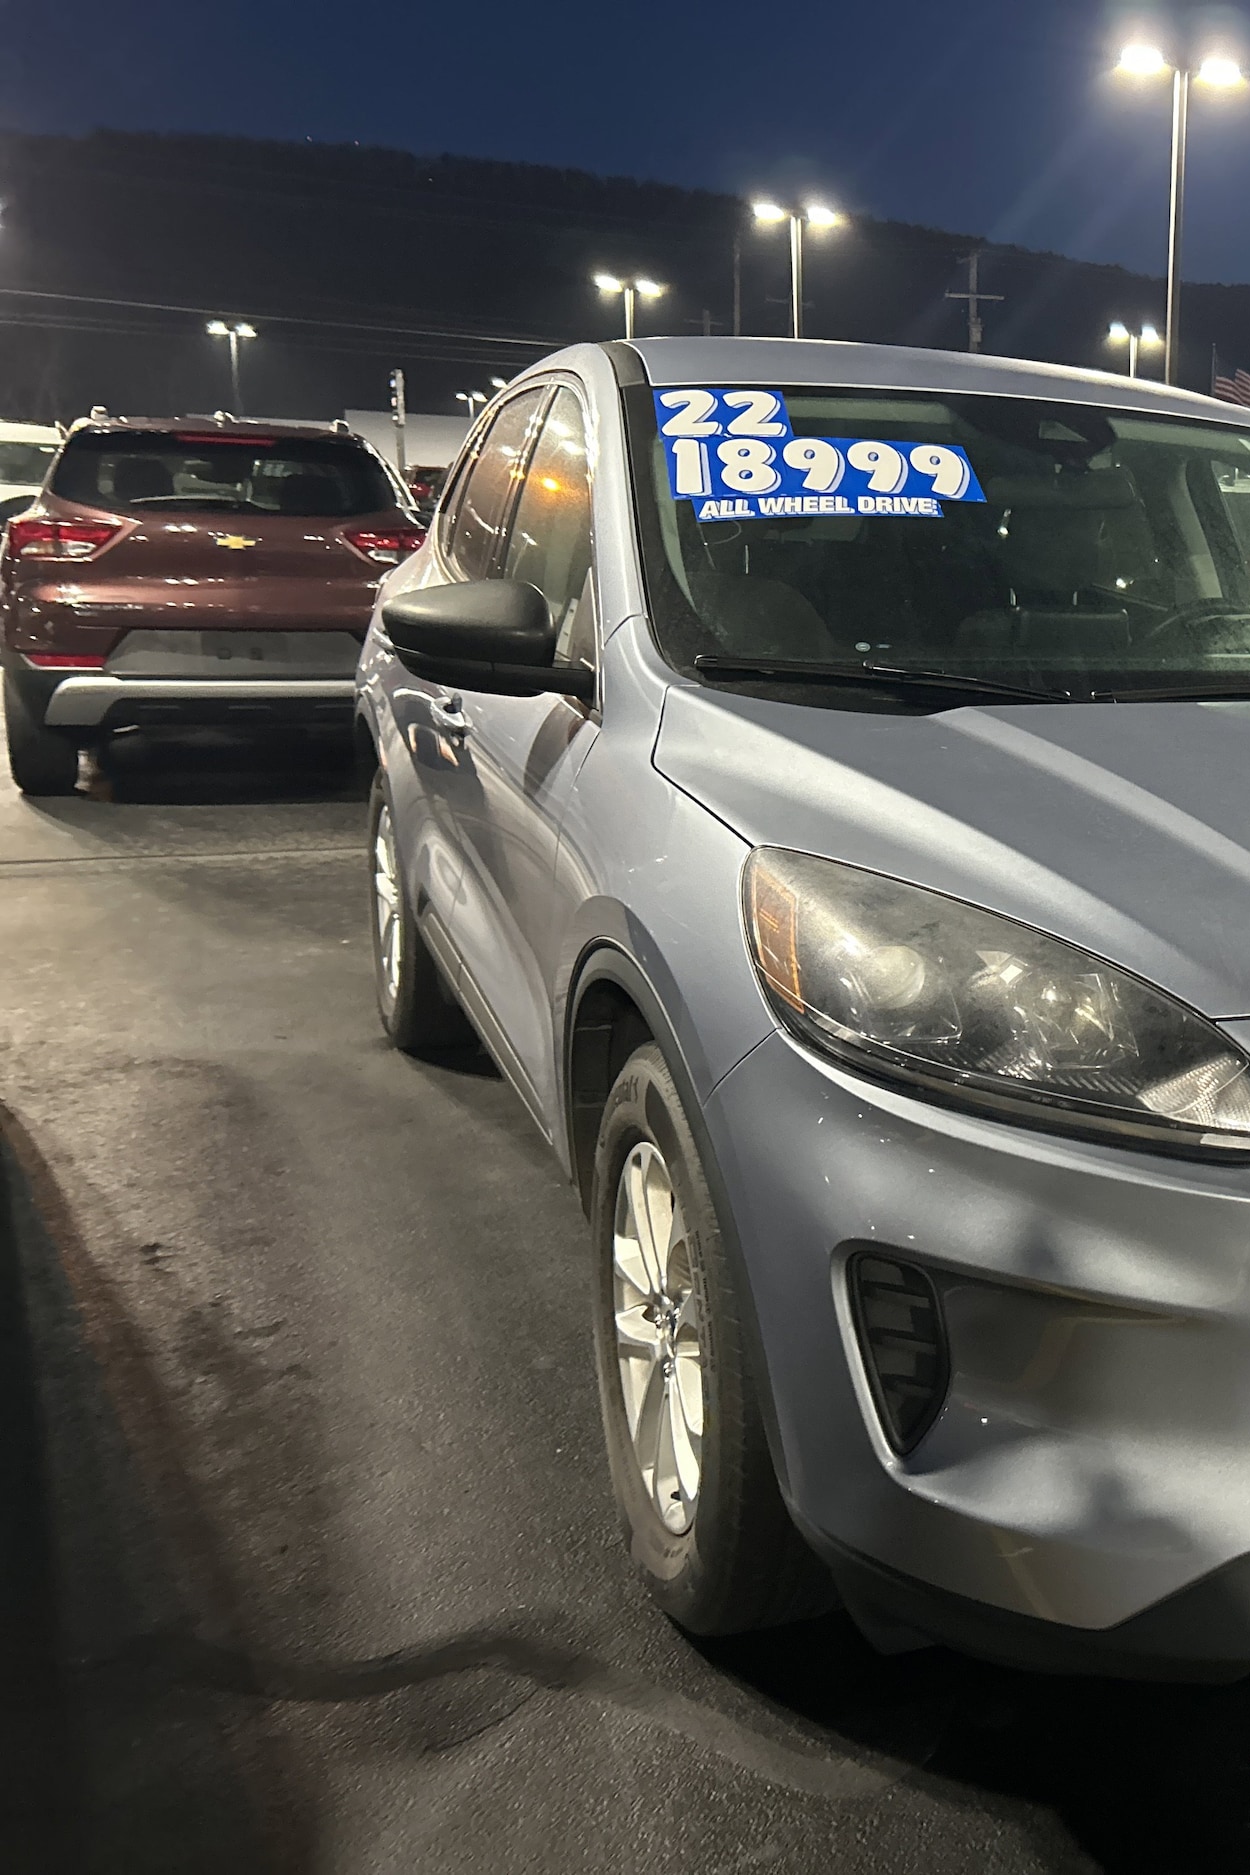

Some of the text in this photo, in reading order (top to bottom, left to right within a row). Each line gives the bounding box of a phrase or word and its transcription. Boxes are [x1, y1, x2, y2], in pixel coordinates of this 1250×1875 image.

[660, 390, 787, 438] 22
[671, 438, 971, 498] 18999
[699, 496, 939, 518] ALL WHEEL DRIVE
